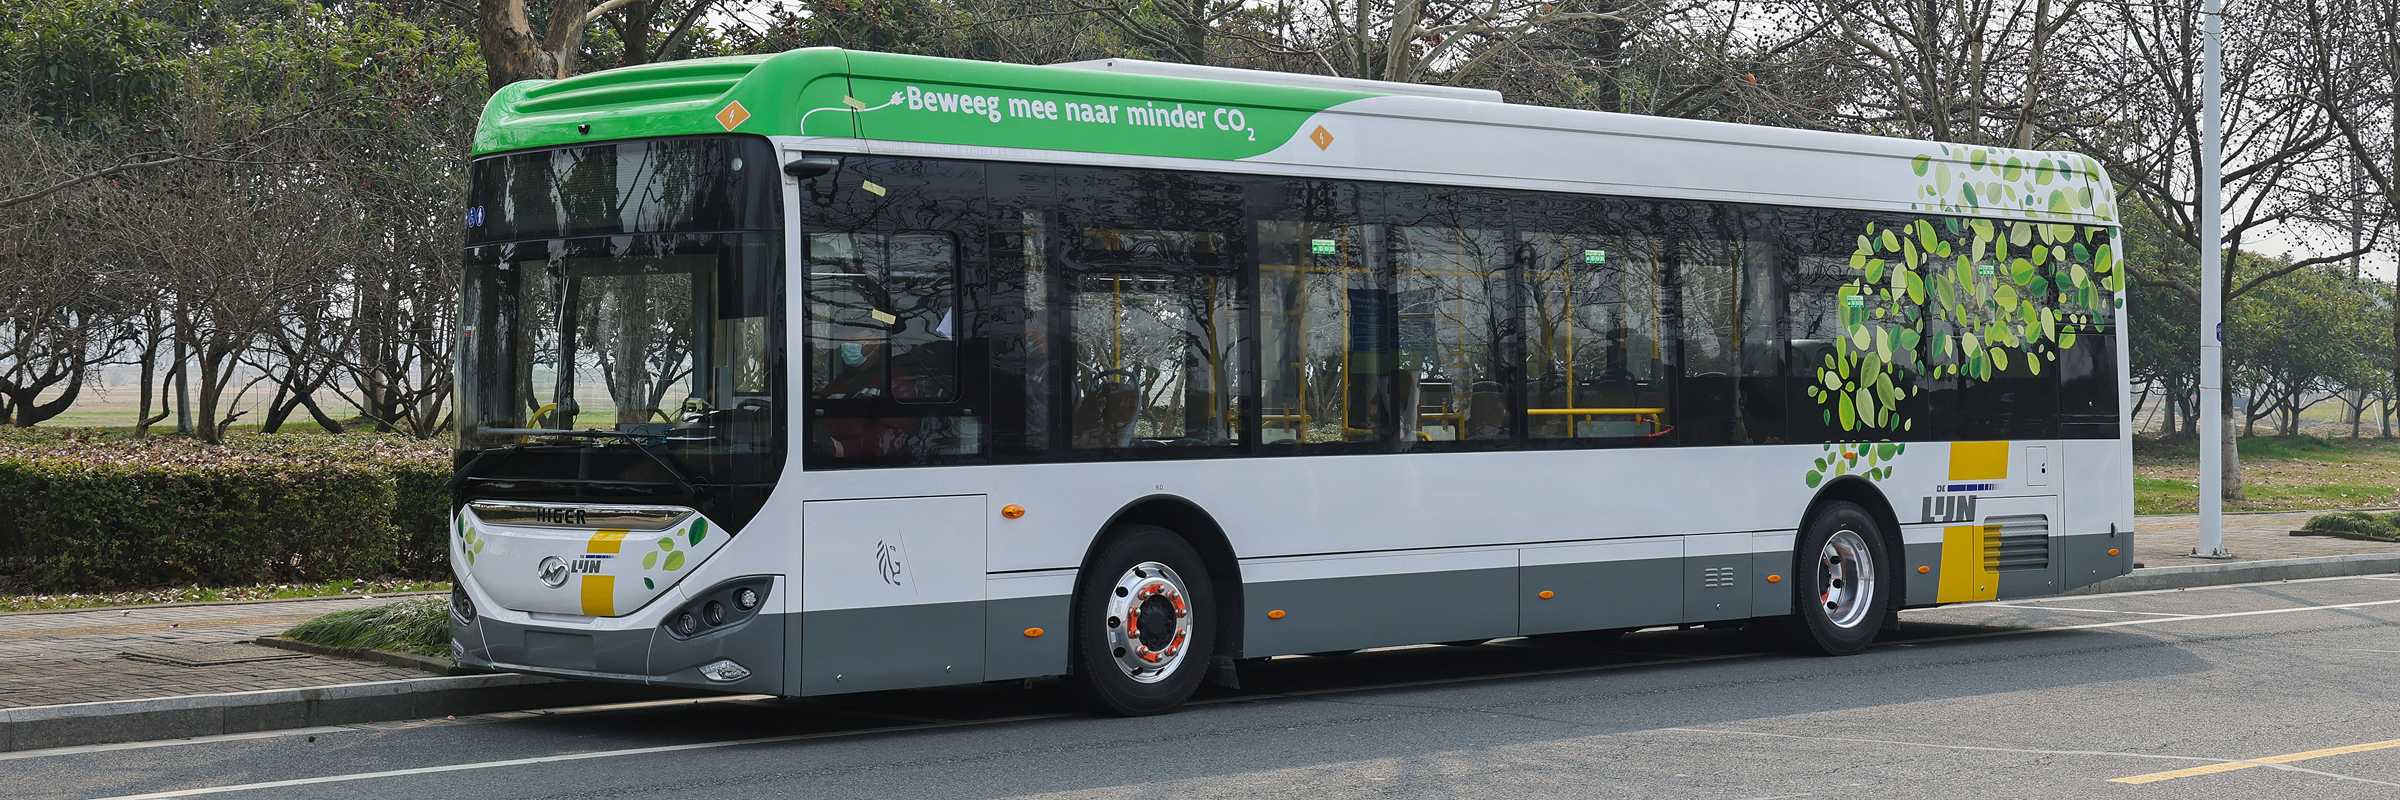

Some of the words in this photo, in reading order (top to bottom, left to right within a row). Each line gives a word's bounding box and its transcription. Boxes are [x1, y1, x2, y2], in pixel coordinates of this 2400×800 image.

[905, 85, 1002, 124] Beweeg
[1008, 97, 1058, 122] mee
[1064, 102, 1119, 125] naar
[1126, 103, 1207, 129] minder
[536, 508, 586, 525] HIGER
[1921, 495, 1977, 523] LIJN
[571, 559, 601, 573] LIJN
